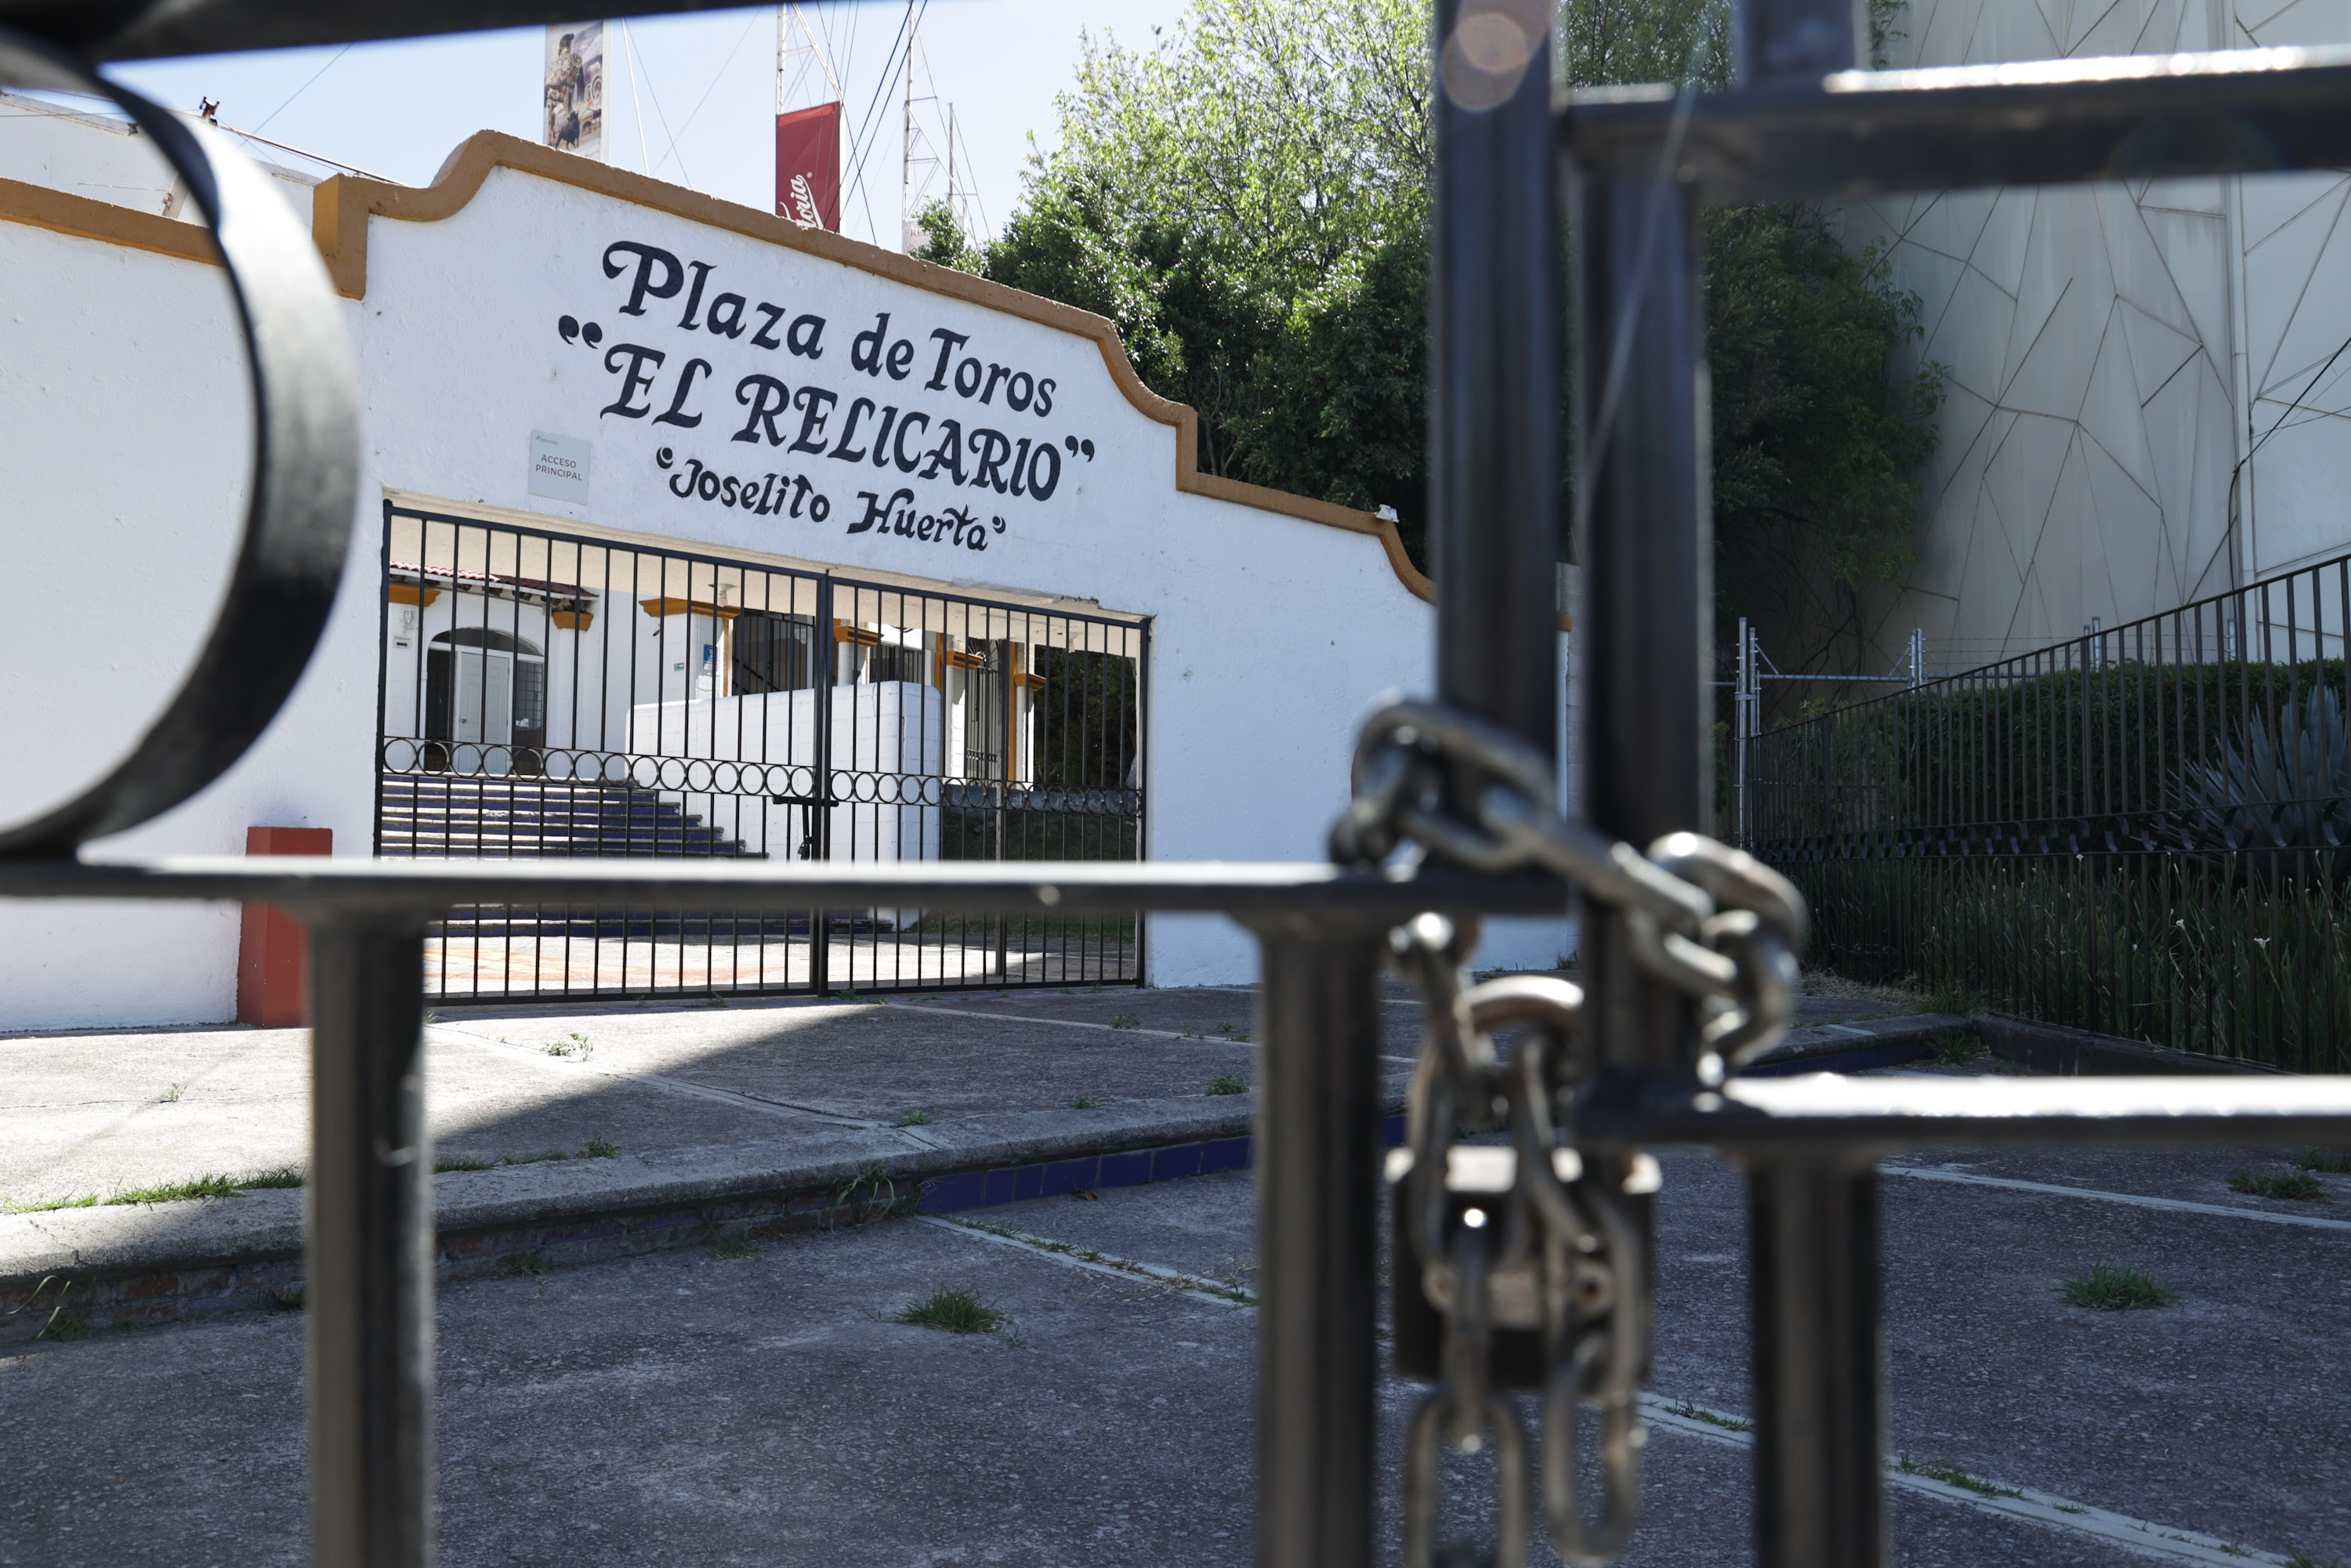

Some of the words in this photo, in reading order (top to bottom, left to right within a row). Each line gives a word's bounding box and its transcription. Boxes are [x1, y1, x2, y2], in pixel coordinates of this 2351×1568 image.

[602, 241, 827, 360] Plaza
[850, 313, 915, 381] de
[924, 328, 1056, 418] Toros
[541, 454, 577, 469] ACCESO
[535, 464, 583, 481] PRINCIPAL
